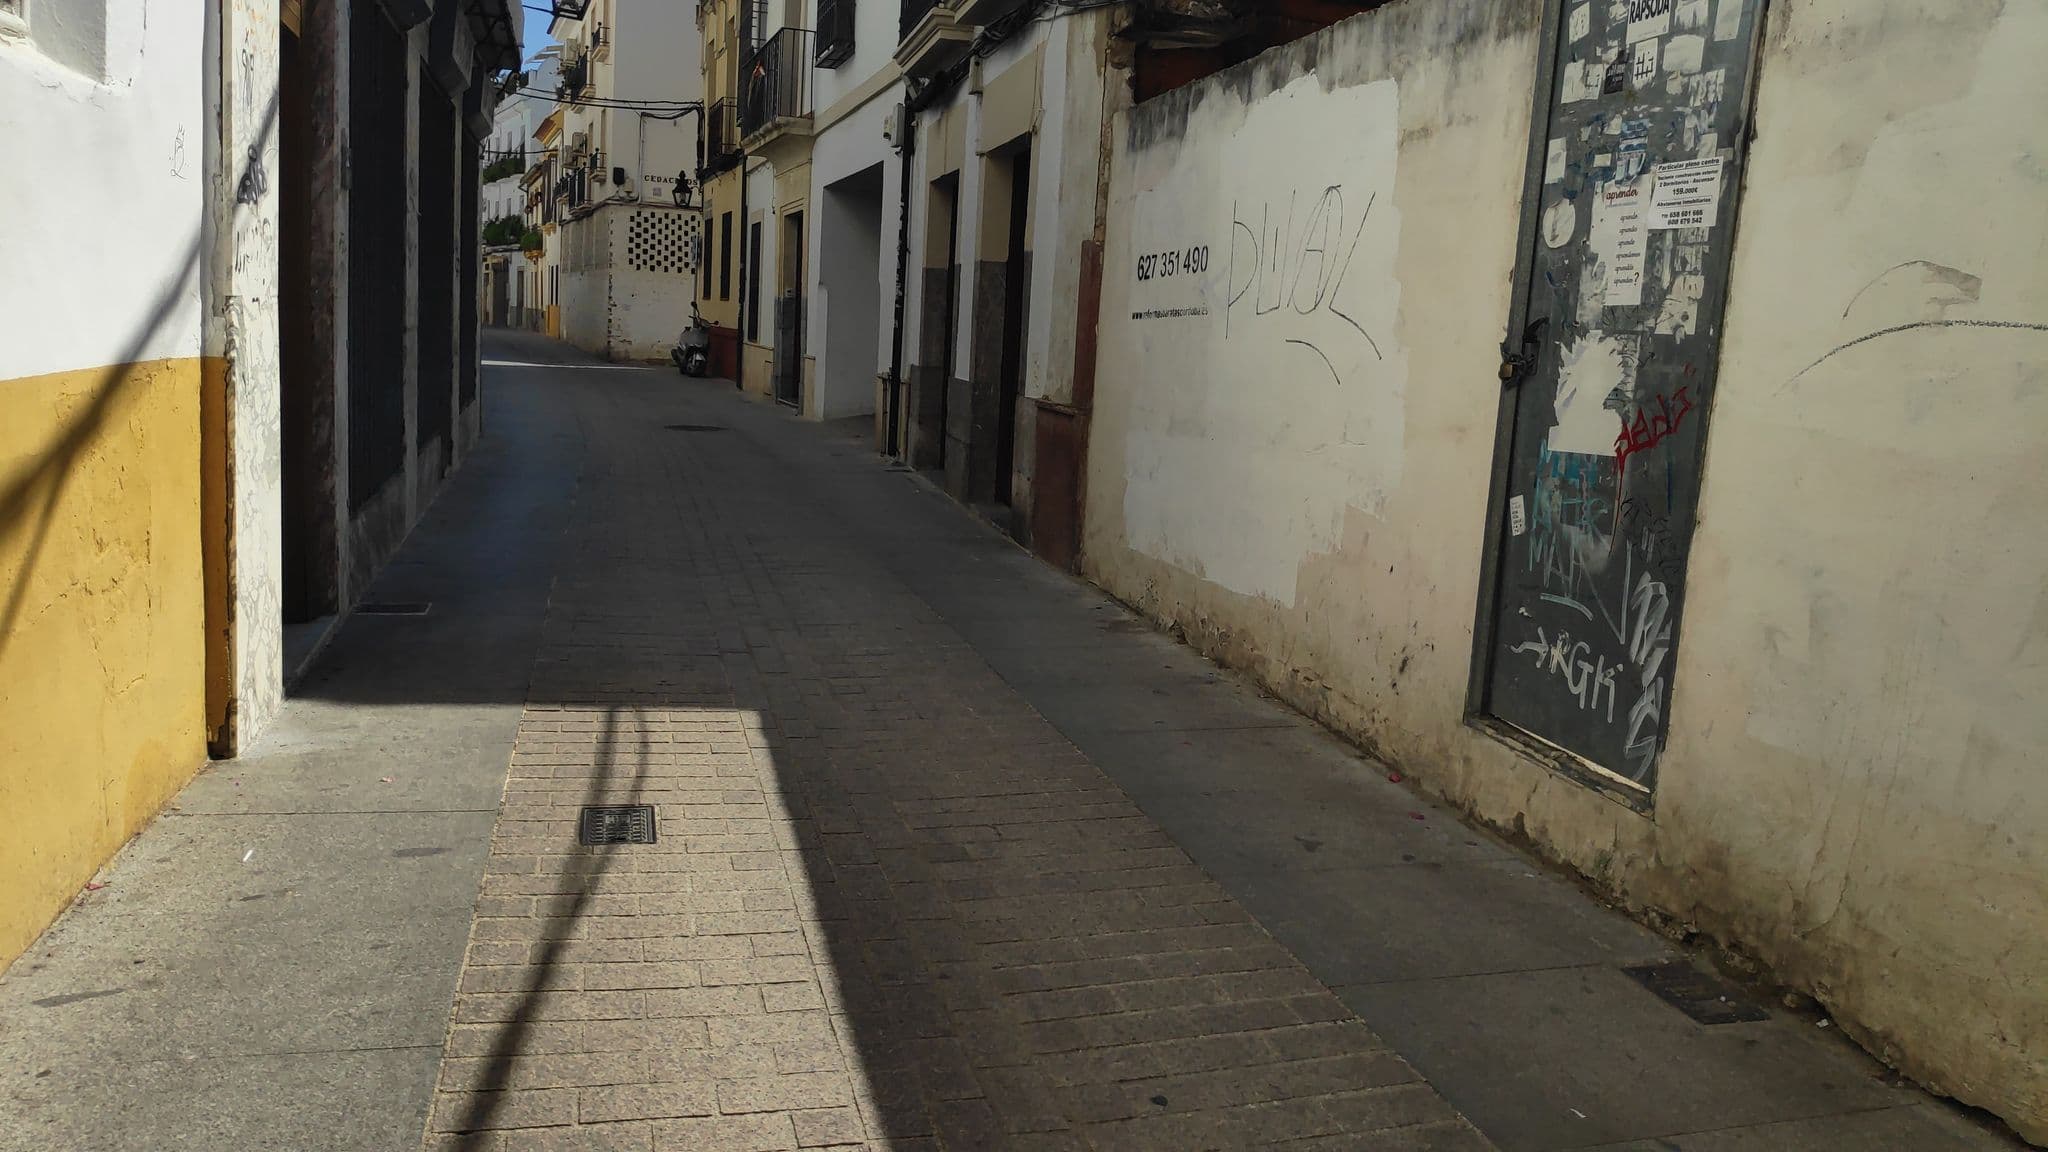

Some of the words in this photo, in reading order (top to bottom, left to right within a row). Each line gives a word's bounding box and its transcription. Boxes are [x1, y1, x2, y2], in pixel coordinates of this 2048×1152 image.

[1658, 162, 1684, 171] Particular
[1685, 160, 1700, 169] pleno
[1701, 158, 1719, 166] centro
[644, 175, 698, 185] CEDACOS
[1606, 187, 1639, 203] aprender
[1137, 254, 1157, 281] 627
[1160, 249, 1180, 277] 351
[1183, 244, 1209, 273] 490
